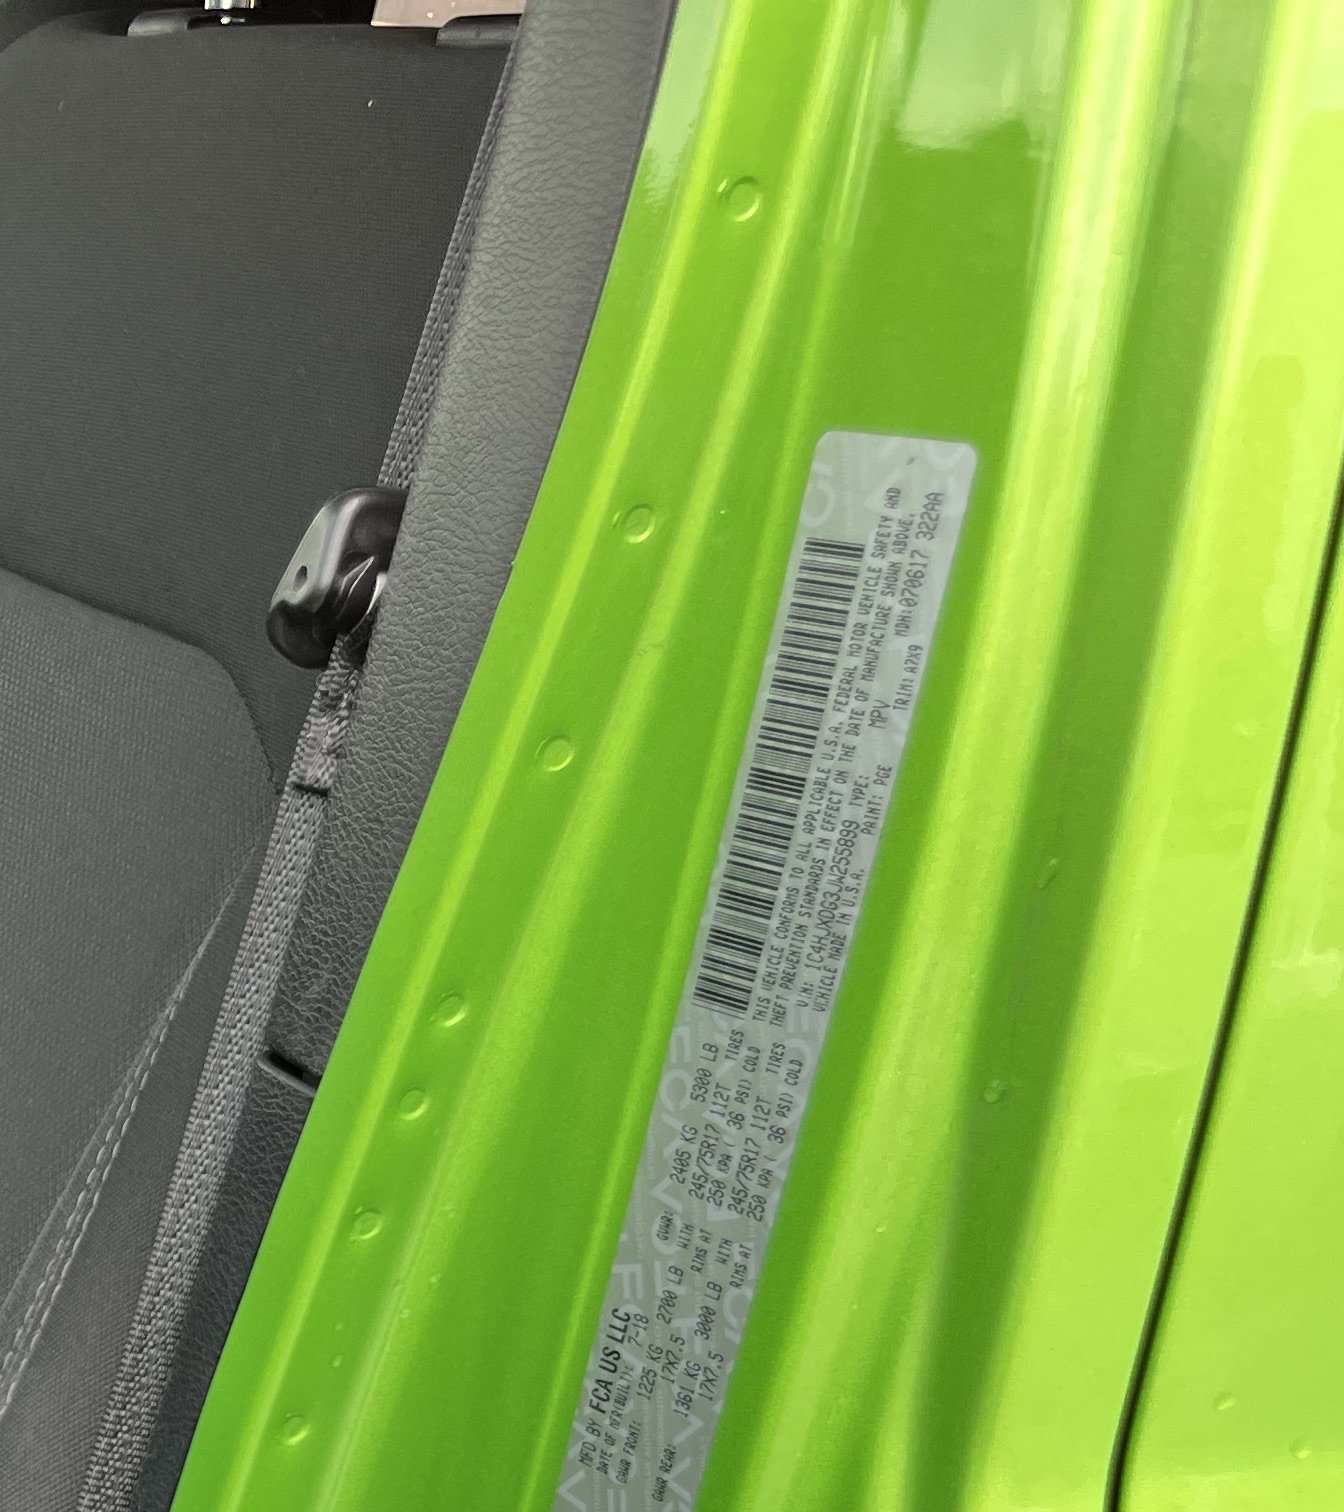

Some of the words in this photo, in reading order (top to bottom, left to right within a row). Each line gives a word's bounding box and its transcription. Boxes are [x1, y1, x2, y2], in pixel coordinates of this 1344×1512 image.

[885, 486, 901, 509] AND
[914, 491, 944, 541] 322AA
[870, 515, 893, 559] SAFETY
[891, 513, 914, 554] ABOVE.
[856, 565, 882, 615] VEHICLE
[879, 561, 902, 597] SHOWN
[846, 621, 868, 657] MOTOR
[859, 603, 892, 682] MANUFACTURE
[831, 665, 858, 712] FEDERAL
[853, 687, 869, 702] OF
[891, 677, 914, 710] TRIM:
[843, 707, 866, 737] DATE
[819, 721, 843, 761] U.S.A.
[837, 742, 856, 762] THE
[833, 769, 848, 784] ON
[872, 764, 892, 786] PGE
[801, 765, 831, 835] APPLICABLE
[819, 789, 843, 832] EFFECT
[859, 794, 883, 836] PAINT:
[803, 819, 860, 971] 1C4HJXDG3JW255899
[847, 774, 869, 807] TYPE:
[867, 699, 891, 729] MPV
[814, 836, 831, 850] IN
[794, 841, 812, 862] ALL
[788, 866, 805, 879] TO
[797, 857, 826, 918] STANDARDS
[840, 868, 864, 907] U.S.A.
[773, 886, 800, 940] CONFORMS
[835, 912, 852, 925] IN
[777, 923, 808, 990] PREVENTION
[827, 931, 847, 960] MADE
[760, 944, 785, 991] VEHICLE
[812, 964, 838, 1012] VEHICLE
[751, 995, 771, 1021] THIS
[768, 994, 788, 1027] THEFT
[699, 1042, 719, 1062] LB
[724, 1028, 744, 1060] TIRES
[741, 1045, 761, 1073] COLD
[764, 1041, 786, 1074] TIRES
[689, 1067, 712, 1103] 5300
[783, 1058, 803, 1086] COLD
[708, 1081, 731, 1118] 112T
[733, 1078, 752, 1105] PSI)
[774, 1092, 793, 1118] PSI)
[725, 1110, 745, 1130] 36
[749, 1094, 772, 1131] 112T
[679, 1124, 698, 1144] KG
[766, 1124, 786, 1144] 36
[668, 1148, 691, 1184] 2405
[687, 1122, 720, 1200] 245/75R17
[717, 1152, 732, 1174] KPA
[726, 1136, 761, 1215] 245/75R17
[705, 1178, 727, 1207] 250
[757, 1167, 773, 1189] KPA
[745, 1193, 767, 1222] 250
[677, 1222, 694, 1250] WITH
[698, 1227, 712, 1244] AT
[738, 1242, 752, 1259] AT
[689, 1246, 708, 1273] RIMS
[714, 1237, 733, 1265] WITH
[666, 1265, 684, 1285] LB
[728, 1261, 747, 1288] RIMS
[703, 1280, 723, 1301] LB
[655, 1289, 678, 1325] 2700
[605, 1307, 631, 1344] LLC
[626, 1312, 650, 1347] 7-18
[693, 1305, 716, 1340] 3000
[598, 1345, 621, 1374] US
[645, 1343, 664, 1363] KG
[659, 1333, 685, 1384] 17X7.5
[635, 1366, 657, 1400] 1225
[682, 1360, 701, 1380] KG
[697, 1349, 724, 1402] 17X7.5
[588, 1378, 614, 1414] FCA
[672, 1384, 695, 1418] 1361
[585, 1417, 601, 1437] BY
[603, 1431, 616, 1446] OF
[622, 1420, 641, 1456] FRONT:
[577, 1440, 597, 1467] MFD
[595, 1448, 613, 1475] DATE
[658, 1443, 676, 1473] REAR:
